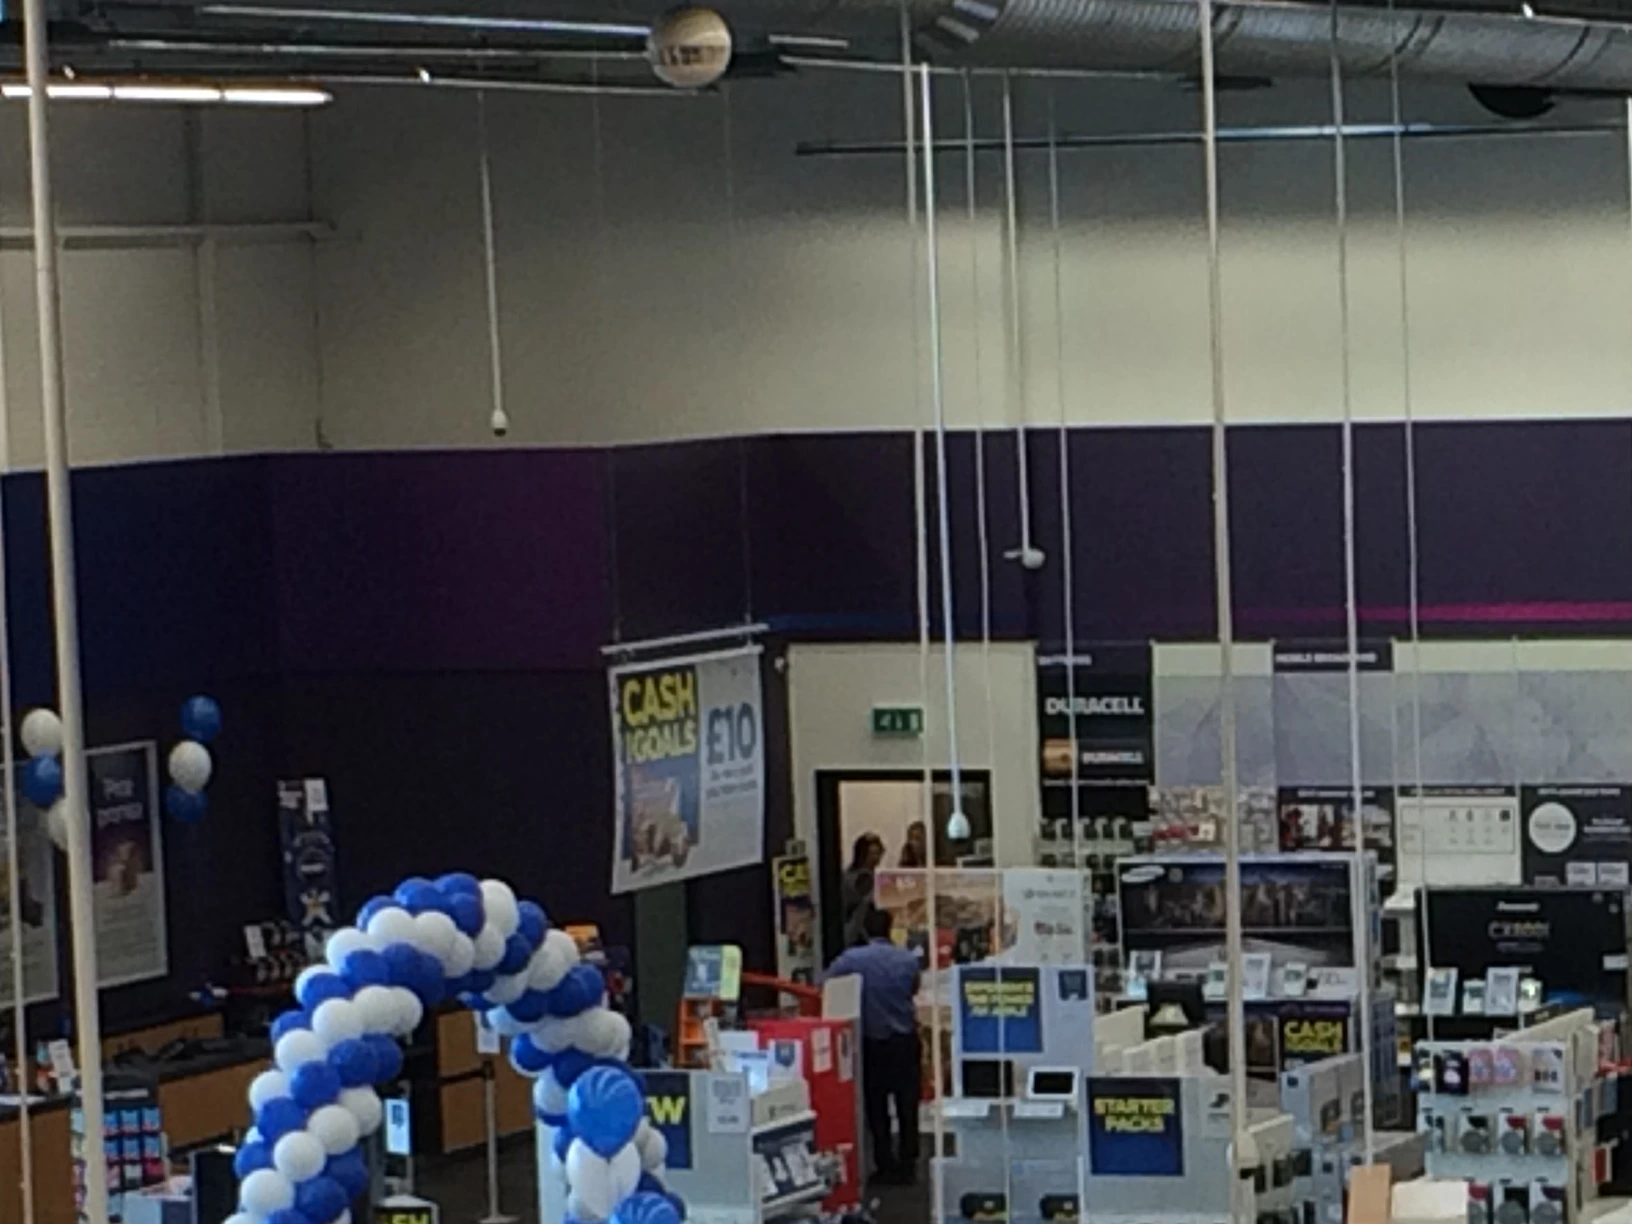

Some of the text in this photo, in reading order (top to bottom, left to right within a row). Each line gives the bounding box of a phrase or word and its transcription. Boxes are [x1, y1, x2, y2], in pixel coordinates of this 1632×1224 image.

[623, 671, 695, 728] CASH
[1045, 697, 1145, 715] DURACELL
[706, 702, 756, 766] £10
[1094, 1098, 1175, 1115] STARTER
[1105, 1116, 1165, 1132] PACKS
